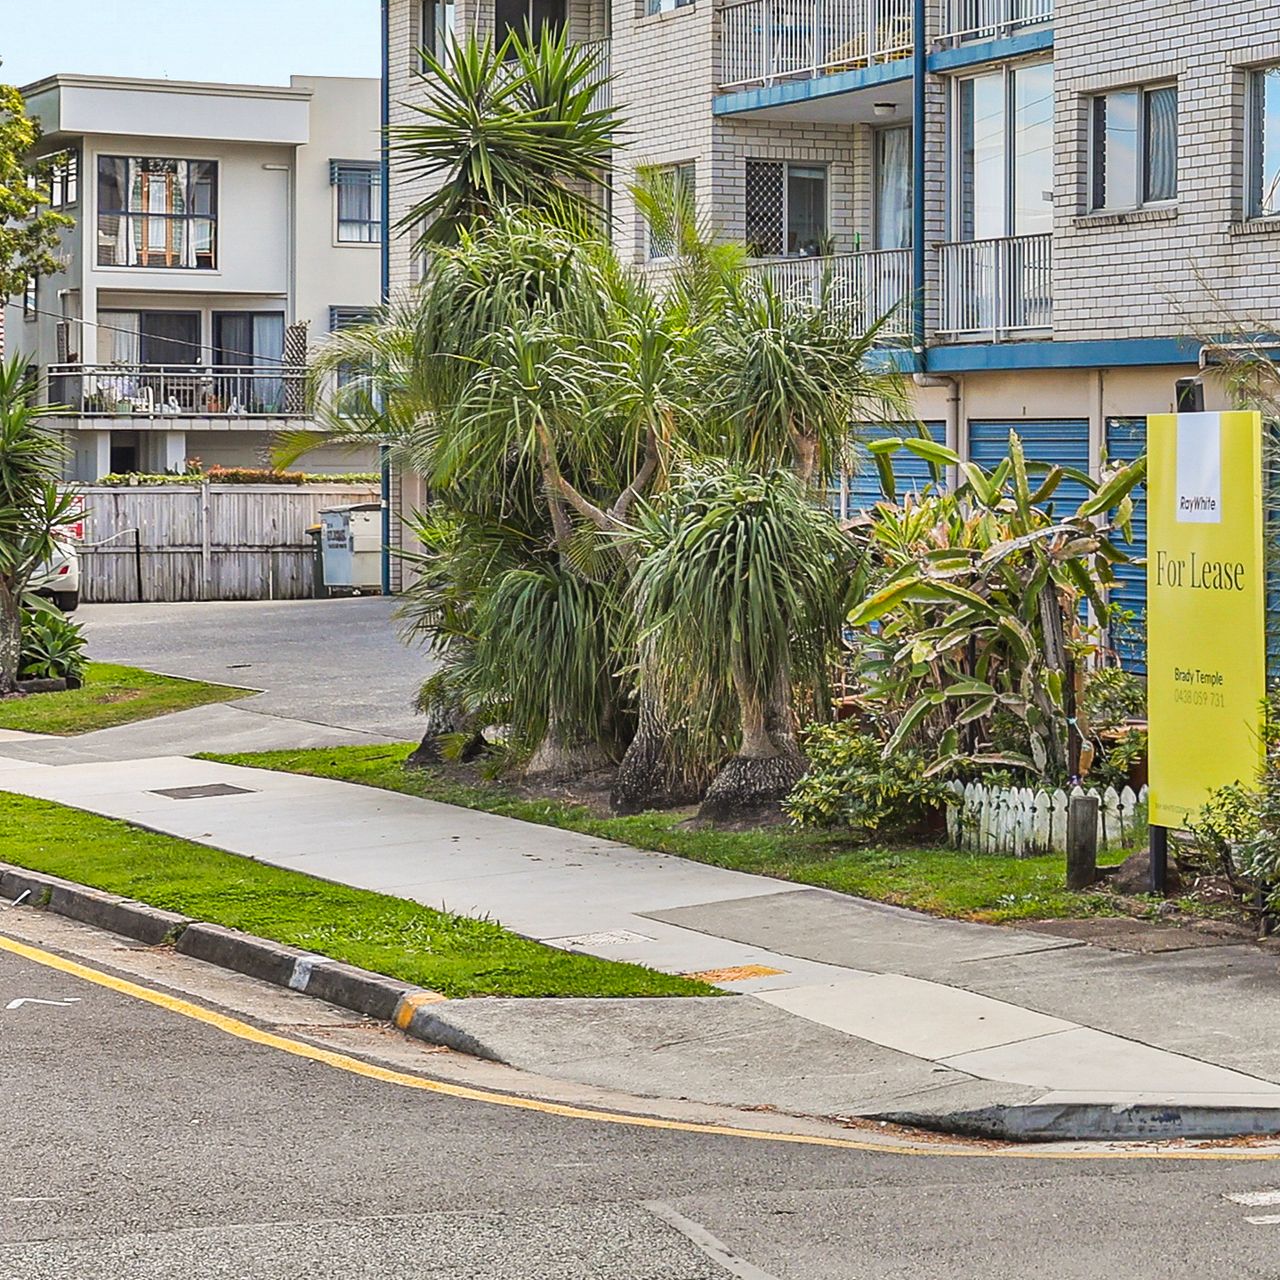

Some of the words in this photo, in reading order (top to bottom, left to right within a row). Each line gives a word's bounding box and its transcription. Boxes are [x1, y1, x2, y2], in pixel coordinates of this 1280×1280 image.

[1180, 496, 1216, 512] RayWhite
[1156, 550, 1186, 587] For
[1190, 552, 1245, 591] Lease
[1175, 667, 1194, 685] Brady
[1196, 669, 1223, 687] Temple
[1175, 689, 1192, 705] 0438
[1193, 690, 1208, 706] 059
[1210, 692, 1224, 708] 731
